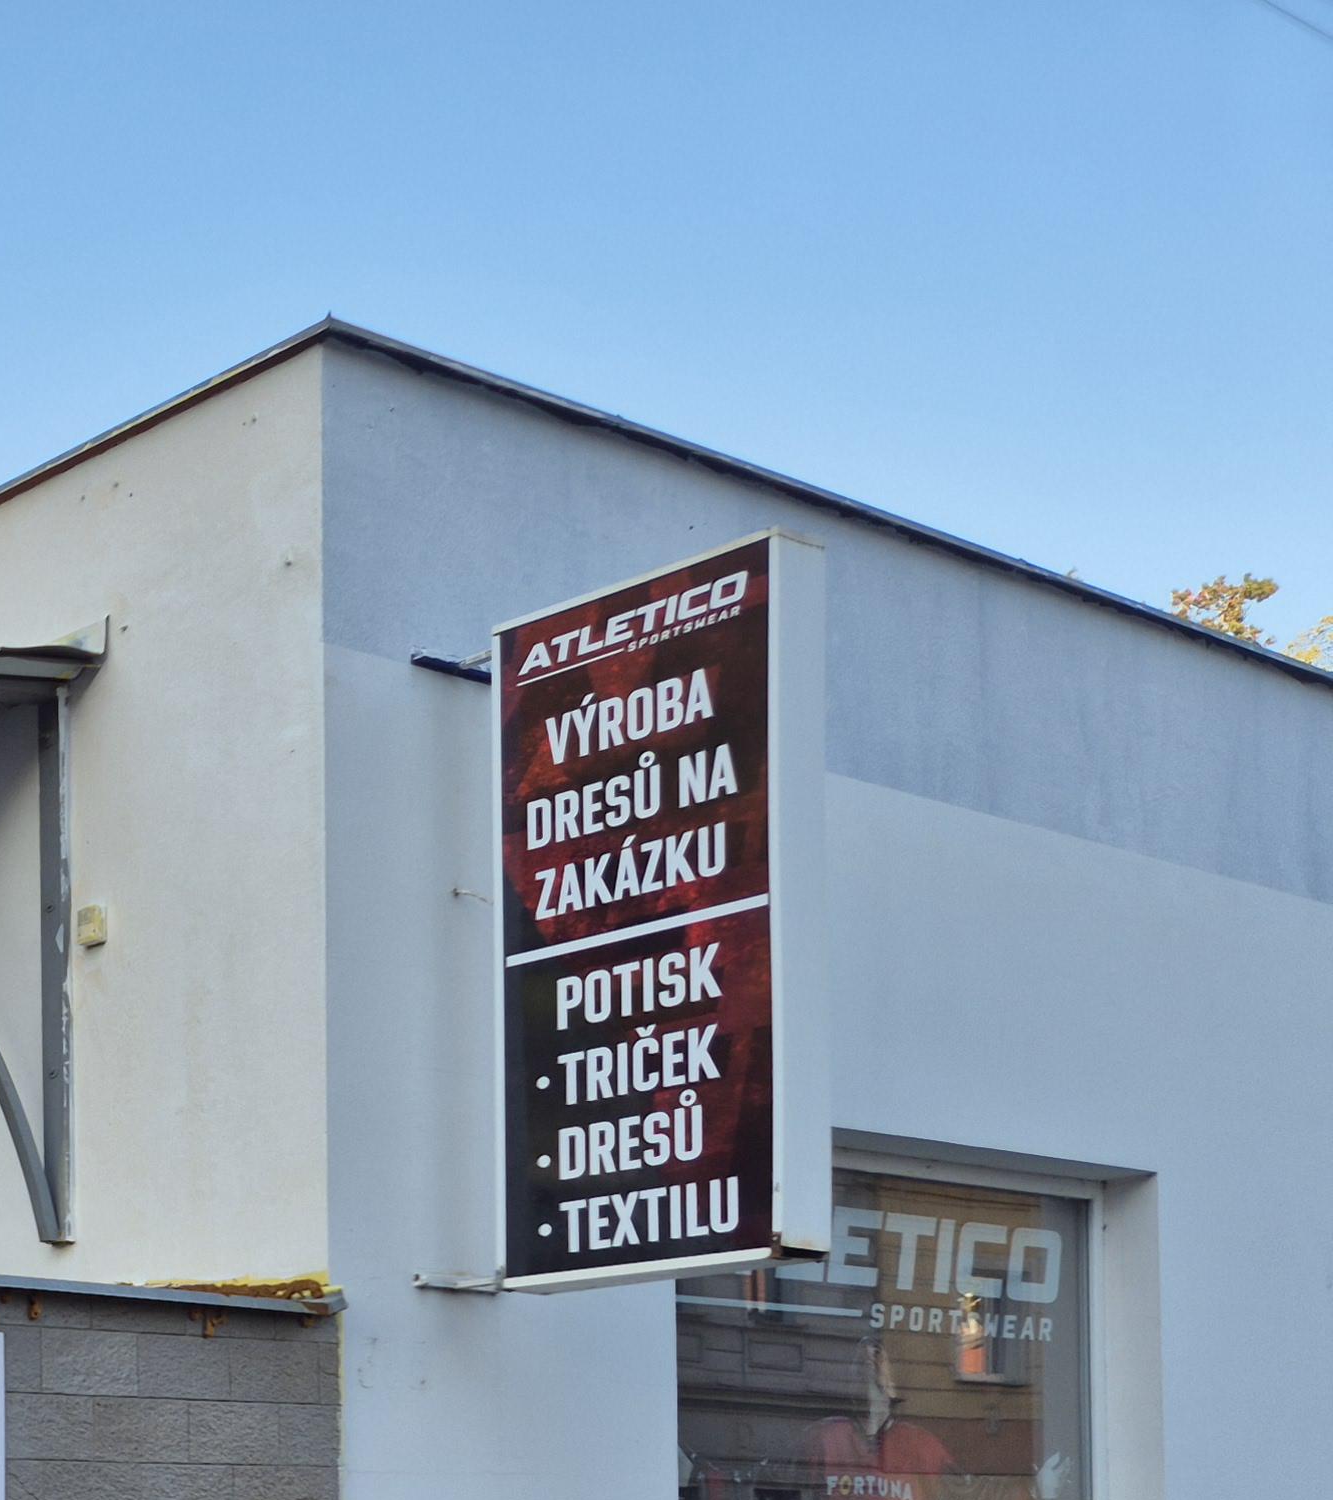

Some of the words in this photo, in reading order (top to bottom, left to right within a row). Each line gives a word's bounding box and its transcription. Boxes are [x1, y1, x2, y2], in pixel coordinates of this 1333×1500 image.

[518, 570, 749, 676] ATLETICO
[627, 605, 741, 652] SPORTSWEAR
[545, 667, 715, 766] VÝROBA
[526, 751, 662, 850] DRESŮ
[678, 742, 738, 810] NA
[534, 821, 727, 920] ZAKÁZKU
[555, 942, 723, 1031] POTISK
[557, 1024, 721, 1105] TRIČEK
[558, 1089, 704, 1181] DRESŮ
[559, 1176, 740, 1254] TEXTILU
